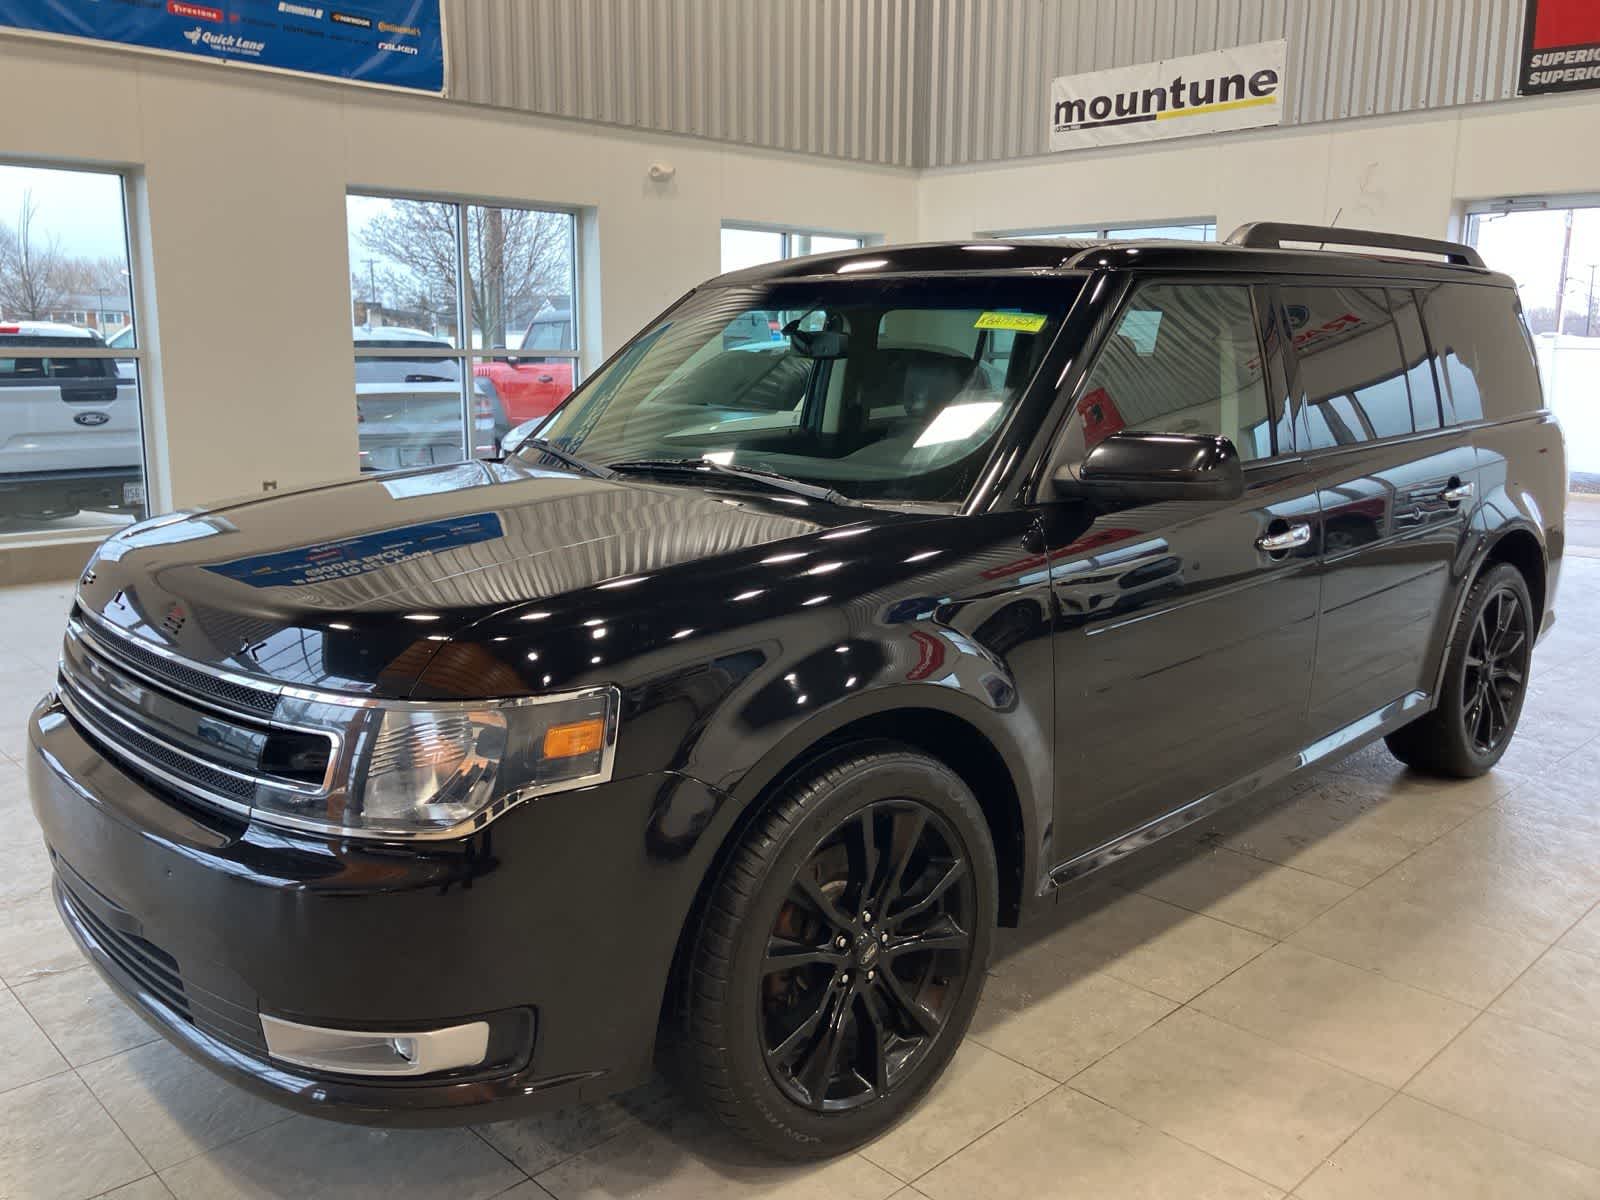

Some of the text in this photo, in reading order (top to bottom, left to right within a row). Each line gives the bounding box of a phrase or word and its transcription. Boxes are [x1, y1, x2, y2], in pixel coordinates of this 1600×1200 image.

[201, 31, 236, 46] Quick
[236, 36, 266, 52] Lane
[1054, 69, 1278, 125] mountune
